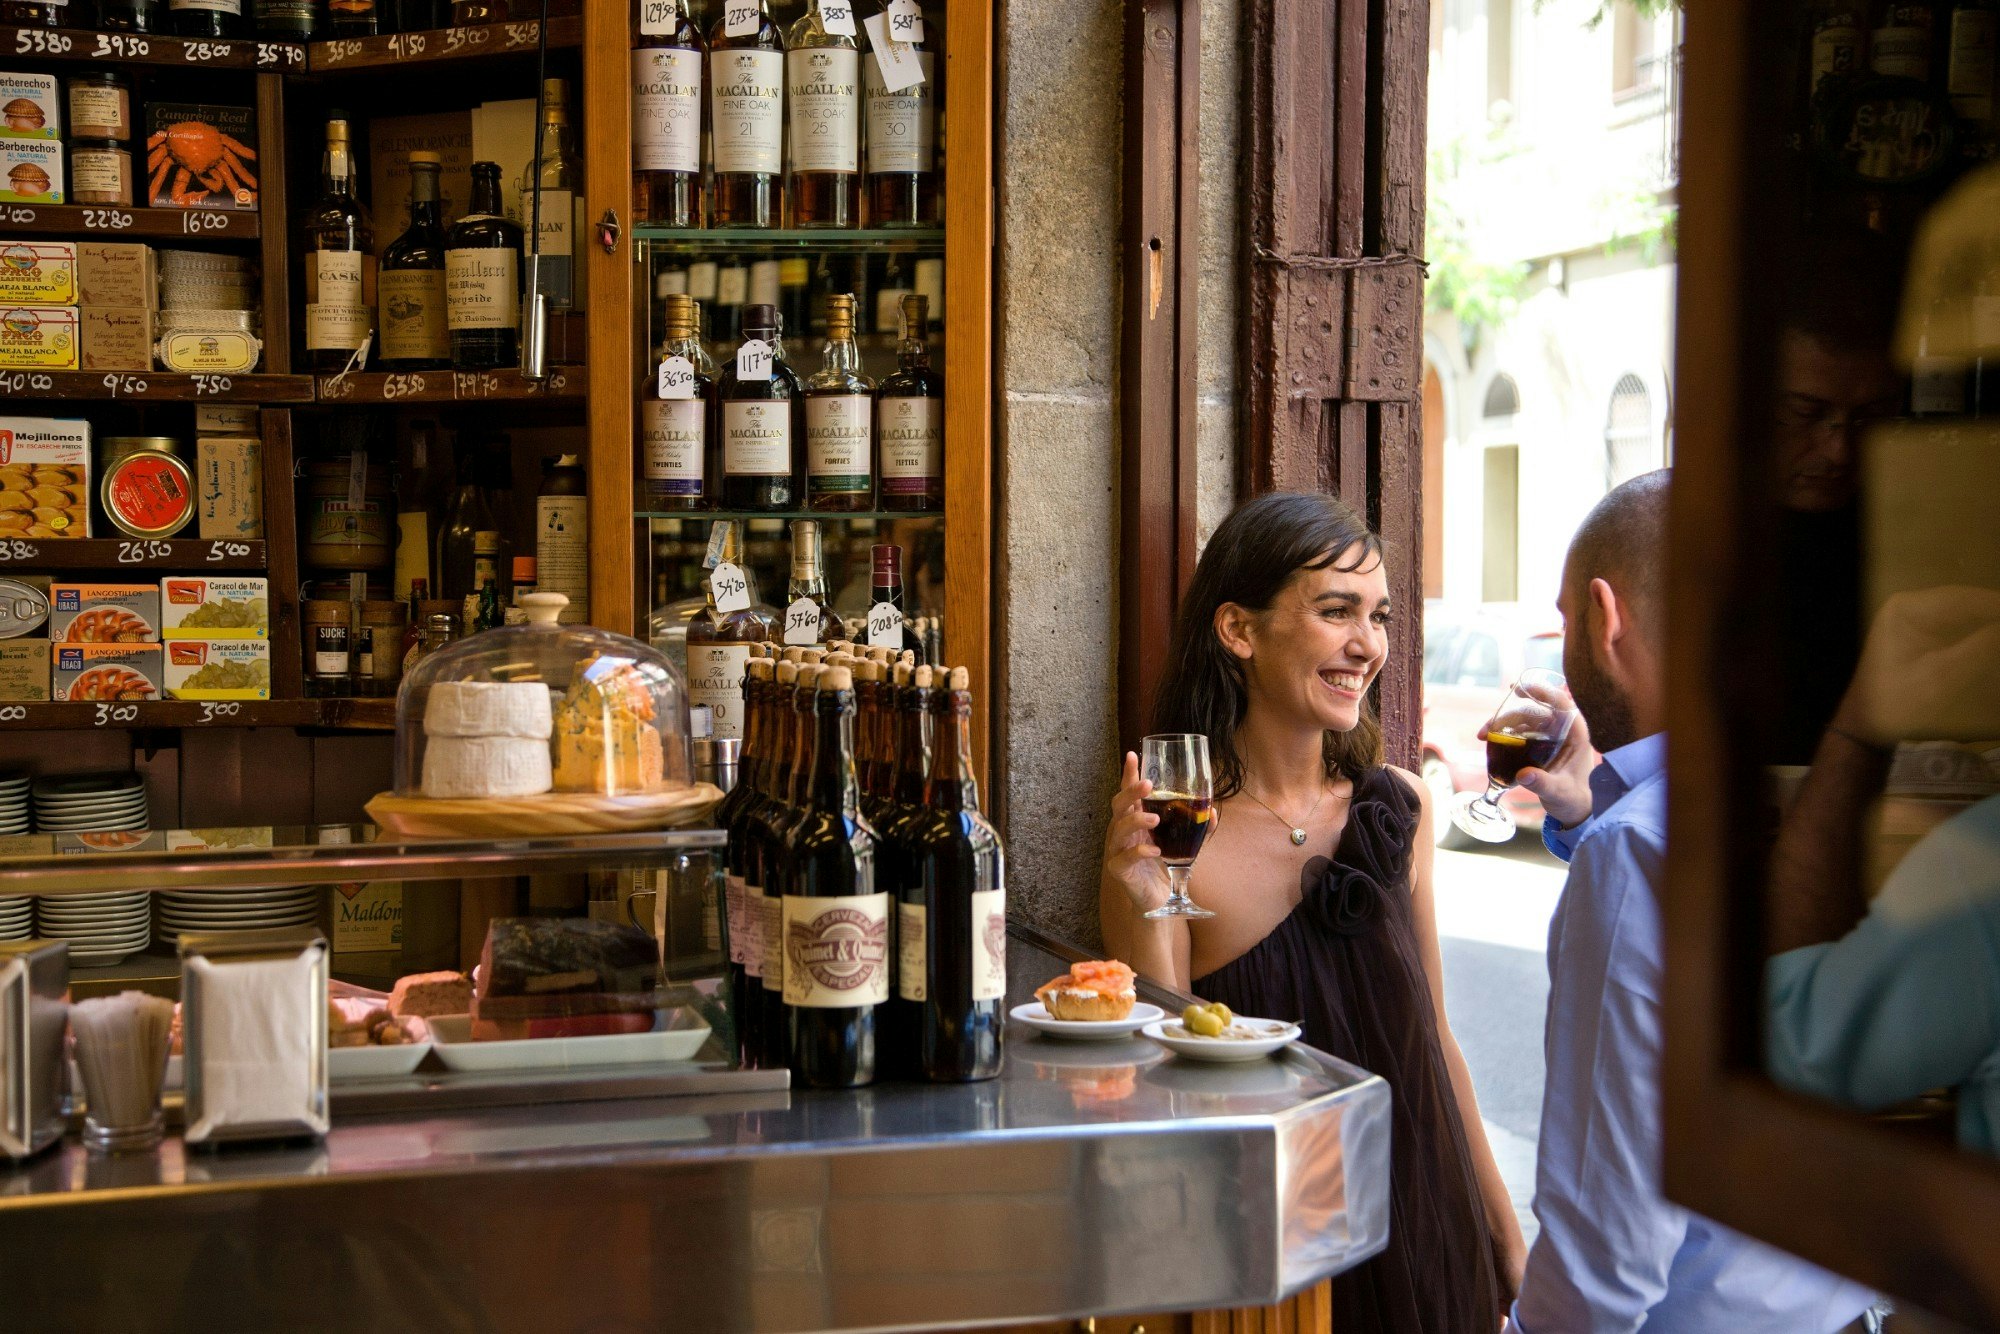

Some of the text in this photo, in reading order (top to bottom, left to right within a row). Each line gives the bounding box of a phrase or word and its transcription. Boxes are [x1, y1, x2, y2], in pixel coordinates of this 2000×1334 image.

[645, 2, 675, 23] 129'50
[728, 8, 759, 26] 275'50
[16, 29, 72, 54] 53'80
[91, 34, 149, 57] 39'50
[388, 34, 426, 60] 41'50
[183, 42, 231, 61] 28'00
[257, 43, 303, 65] 35'70
[0, 77, 51, 89] erberechos
[655, 72, 673, 83] The
[738, 73, 754, 83] The
[811, 72, 827, 83] The
[634, 84, 699, 97] MACALLAN
[716, 85, 779, 98] MACALLAN
[791, 84, 855, 97] MACALLAN
[723, 100, 771, 110] FINE OAK
[874, 100, 919, 110] FINE OAK
[156, 107, 248, 123] Cangrejo Real
[640, 109, 690, 119] FINE OAK
[797, 109, 846, 118] FINE OAK
[659, 121, 673, 134] 18
[740, 122, 753, 136] 21
[812, 122, 828, 134] 25
[885, 123, 906, 136] 30
[0, 141, 56, 154] Berberechos
[83, 210, 133, 228] 22'80
[183, 211, 228, 232] 16'00
[0, 267, 42, 277] PACO
[319, 272, 360, 281] CASK
[2, 331, 44, 340] PACO
[743, 351, 773, 372] 117'00
[0, 373, 53, 395] 40'00
[103, 373, 147, 398] 9'50
[190, 374, 232, 395] 7'50
[384, 373, 426, 399] 63'50
[453, 371, 499, 400] 179'70
[663, 371, 692, 389] 36'50
[749, 420, 763, 428] The
[15, 433, 83, 442] Mejillones
[643, 431, 700, 441] MACALLAN
[730, 429, 783, 438] MACALLAN
[808, 427, 868, 438] MACALLAN
[880, 429, 939, 440] MACALLAN
[824, 457, 851, 465] FORTIES
[895, 459, 919, 467] FIFTIES
[117, 541, 172, 563] 26'50
[206, 540, 251, 561] 5'00
[209, 582, 263, 591] Caracol de Mar
[717, 578, 745, 602] 34'20
[58, 602, 78, 611] UBAGO
[784, 610, 817, 633] 37'60
[319, 628, 346, 638] SUCRE
[211, 643, 266, 652] Caracol de Mar
[61, 661, 83, 670] UBAGO
[709, 667, 725, 678] The
[690, 680, 742, 690] MACALLA
[94, 703, 138, 726] 3'00
[197, 701, 240, 723] 3'00
[339, 900, 402, 923] Maldon
[813, 909, 872, 931] CERVEZA
[837, 939, 850, 962] &
[812, 965, 873, 989] ESPECIAL
